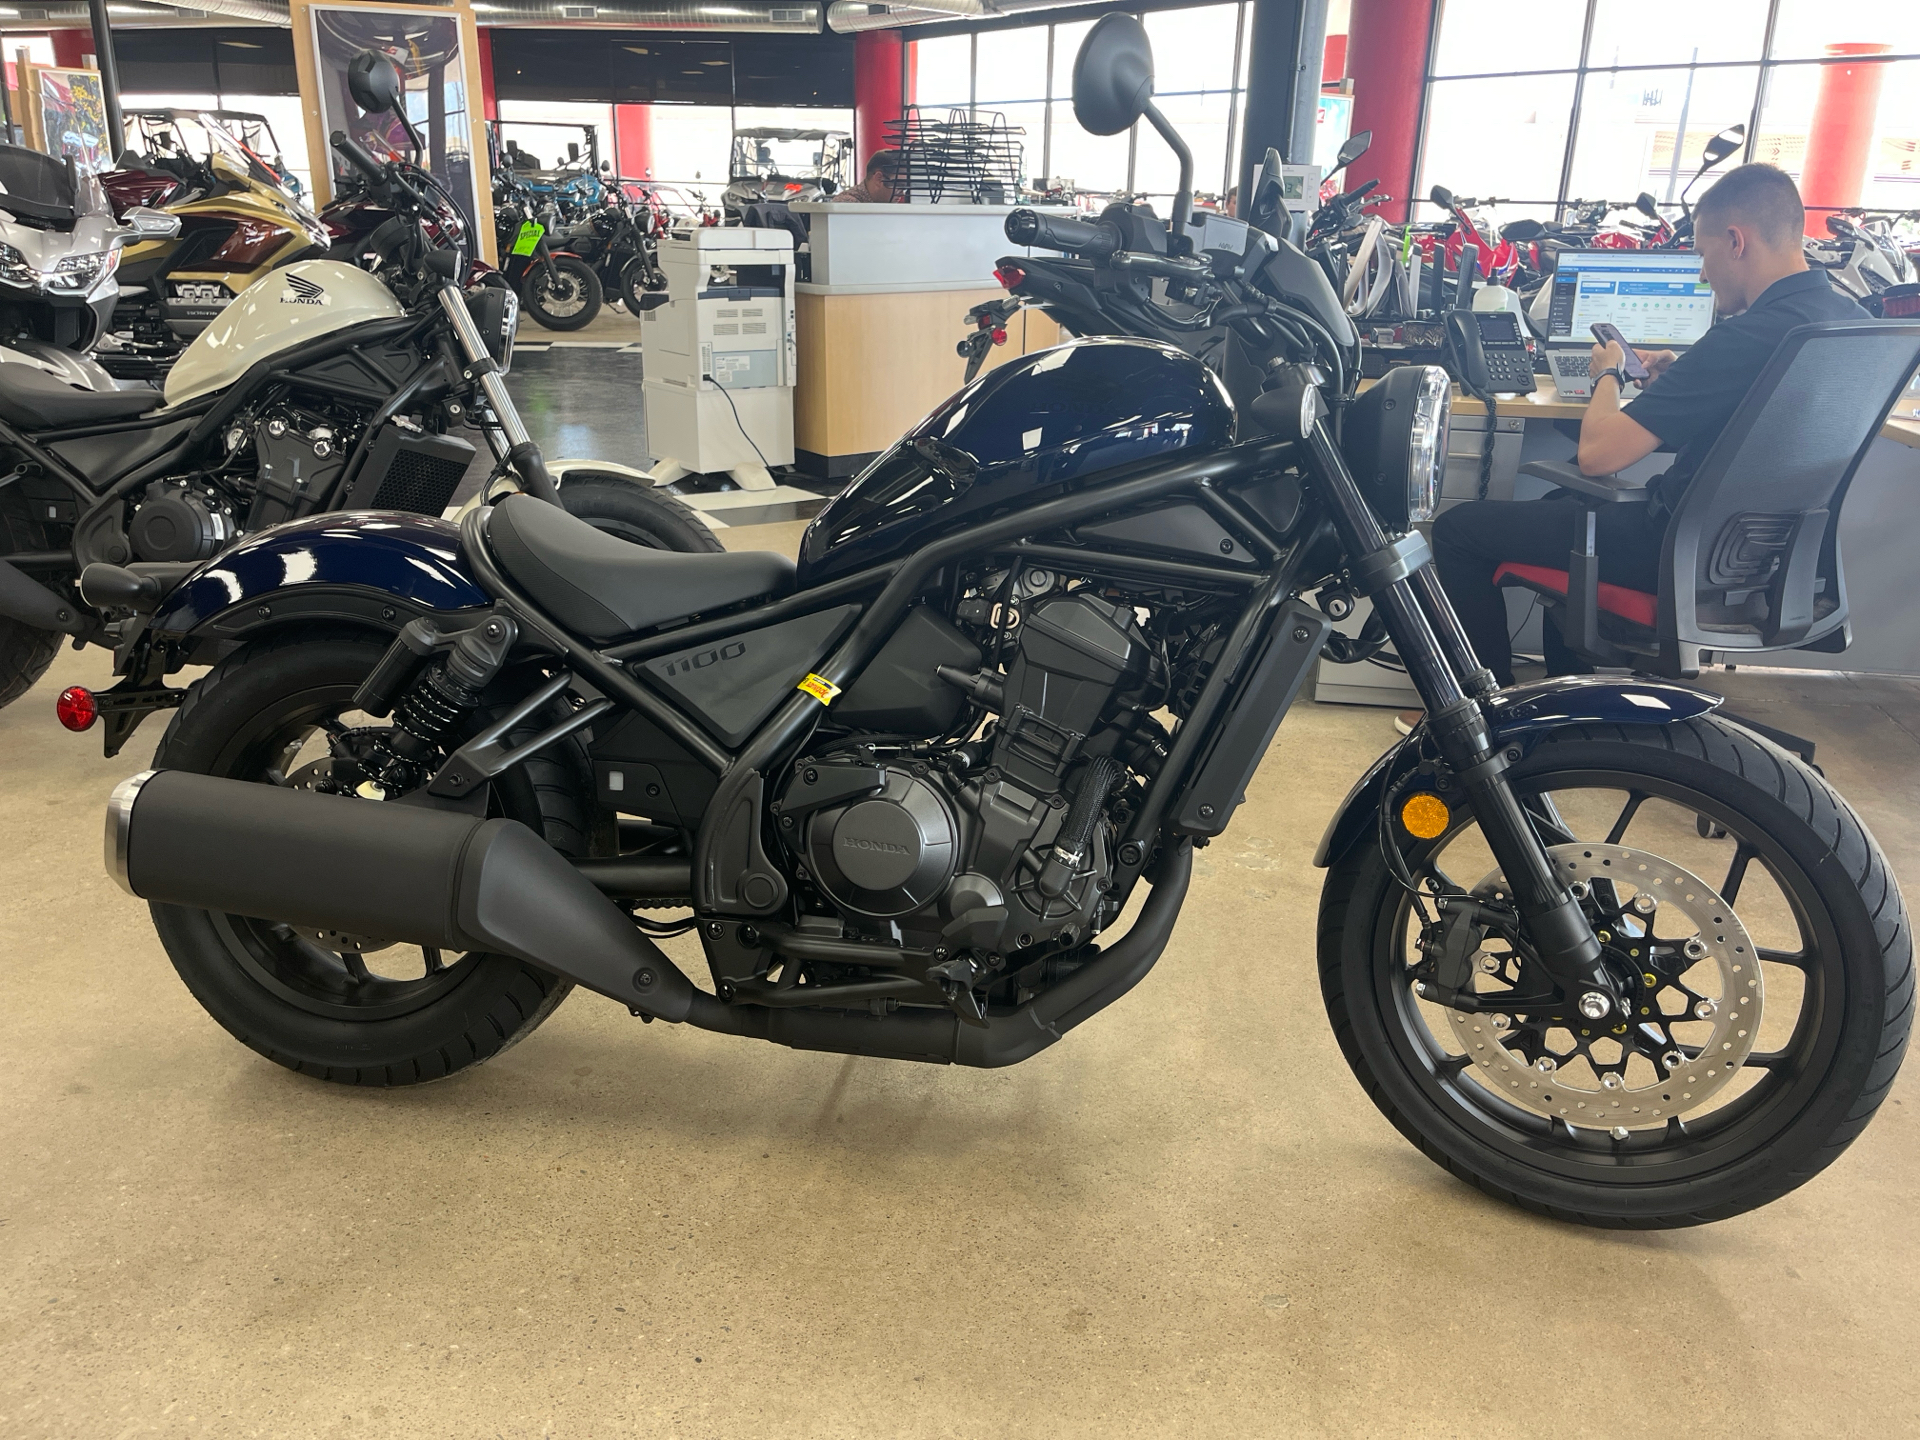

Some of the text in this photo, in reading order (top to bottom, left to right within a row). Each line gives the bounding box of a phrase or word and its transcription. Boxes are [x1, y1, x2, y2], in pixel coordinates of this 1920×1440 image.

[279, 297, 323, 306] HONDA
[661, 641, 746, 676] 1100
[843, 836, 911, 856] HONDA
